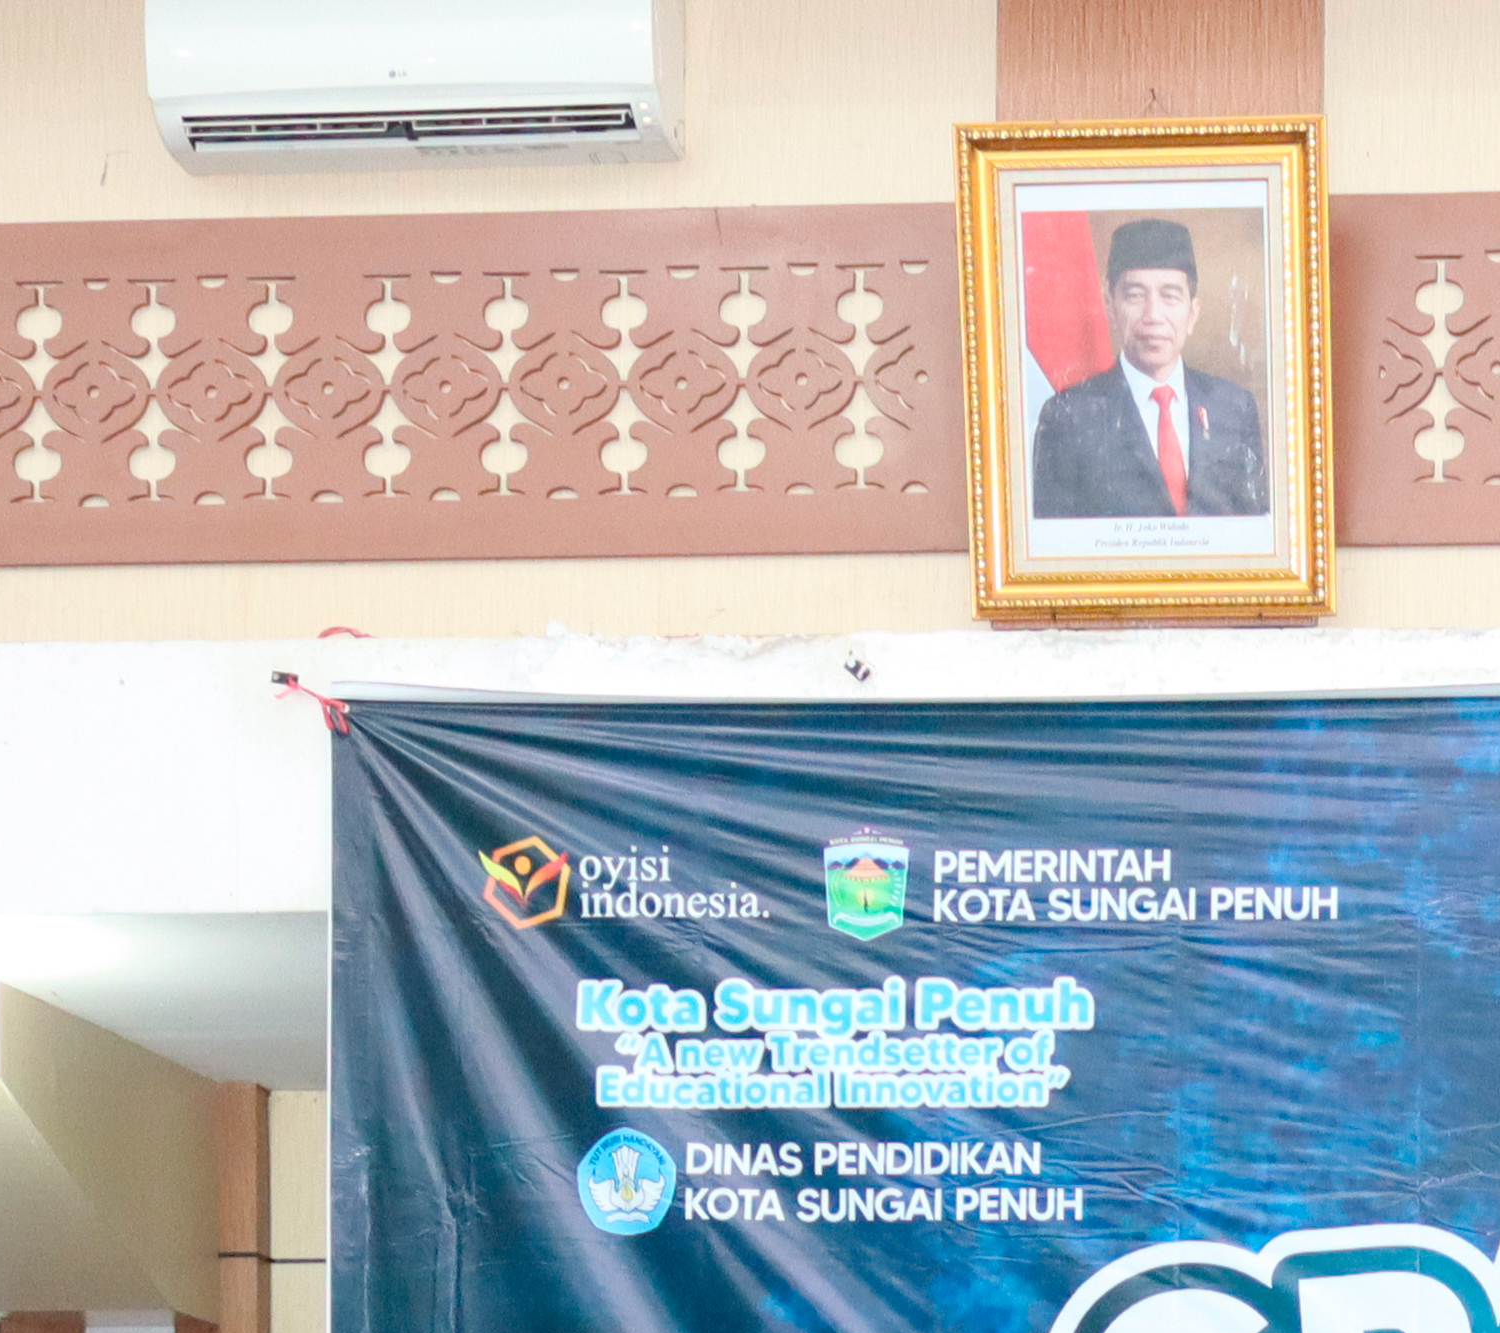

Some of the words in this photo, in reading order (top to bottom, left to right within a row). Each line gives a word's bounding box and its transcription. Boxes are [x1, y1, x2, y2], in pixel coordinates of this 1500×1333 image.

[579, 846, 670, 889] oyisi
[934, 848, 1172, 883] PEMERINTAH
[580, 882, 770, 918] indonesia.
[933, 888, 1038, 924] KOTA
[1047, 887, 1203, 923] SUNGAI
[1210, 885, 1338, 922] PENUH
[577, 980, 706, 1031] Kota
[714, 975, 905, 1039] Sungai
[915, 976, 1095, 1030] Penuh
[676, 1036, 766, 1073] new
[766, 1030, 1001, 1073] Trendsetter
[1002, 1029, 1054, 1070] of
[597, 1067, 830, 1108] Educational
[685, 1142, 803, 1176] DINAS
[814, 1142, 1041, 1176] PENDIDIKAN
[685, 1188, 784, 1222] KOTA
[796, 1188, 942, 1223] SUNGAI
[956, 1188, 1084, 1222] PENUH
